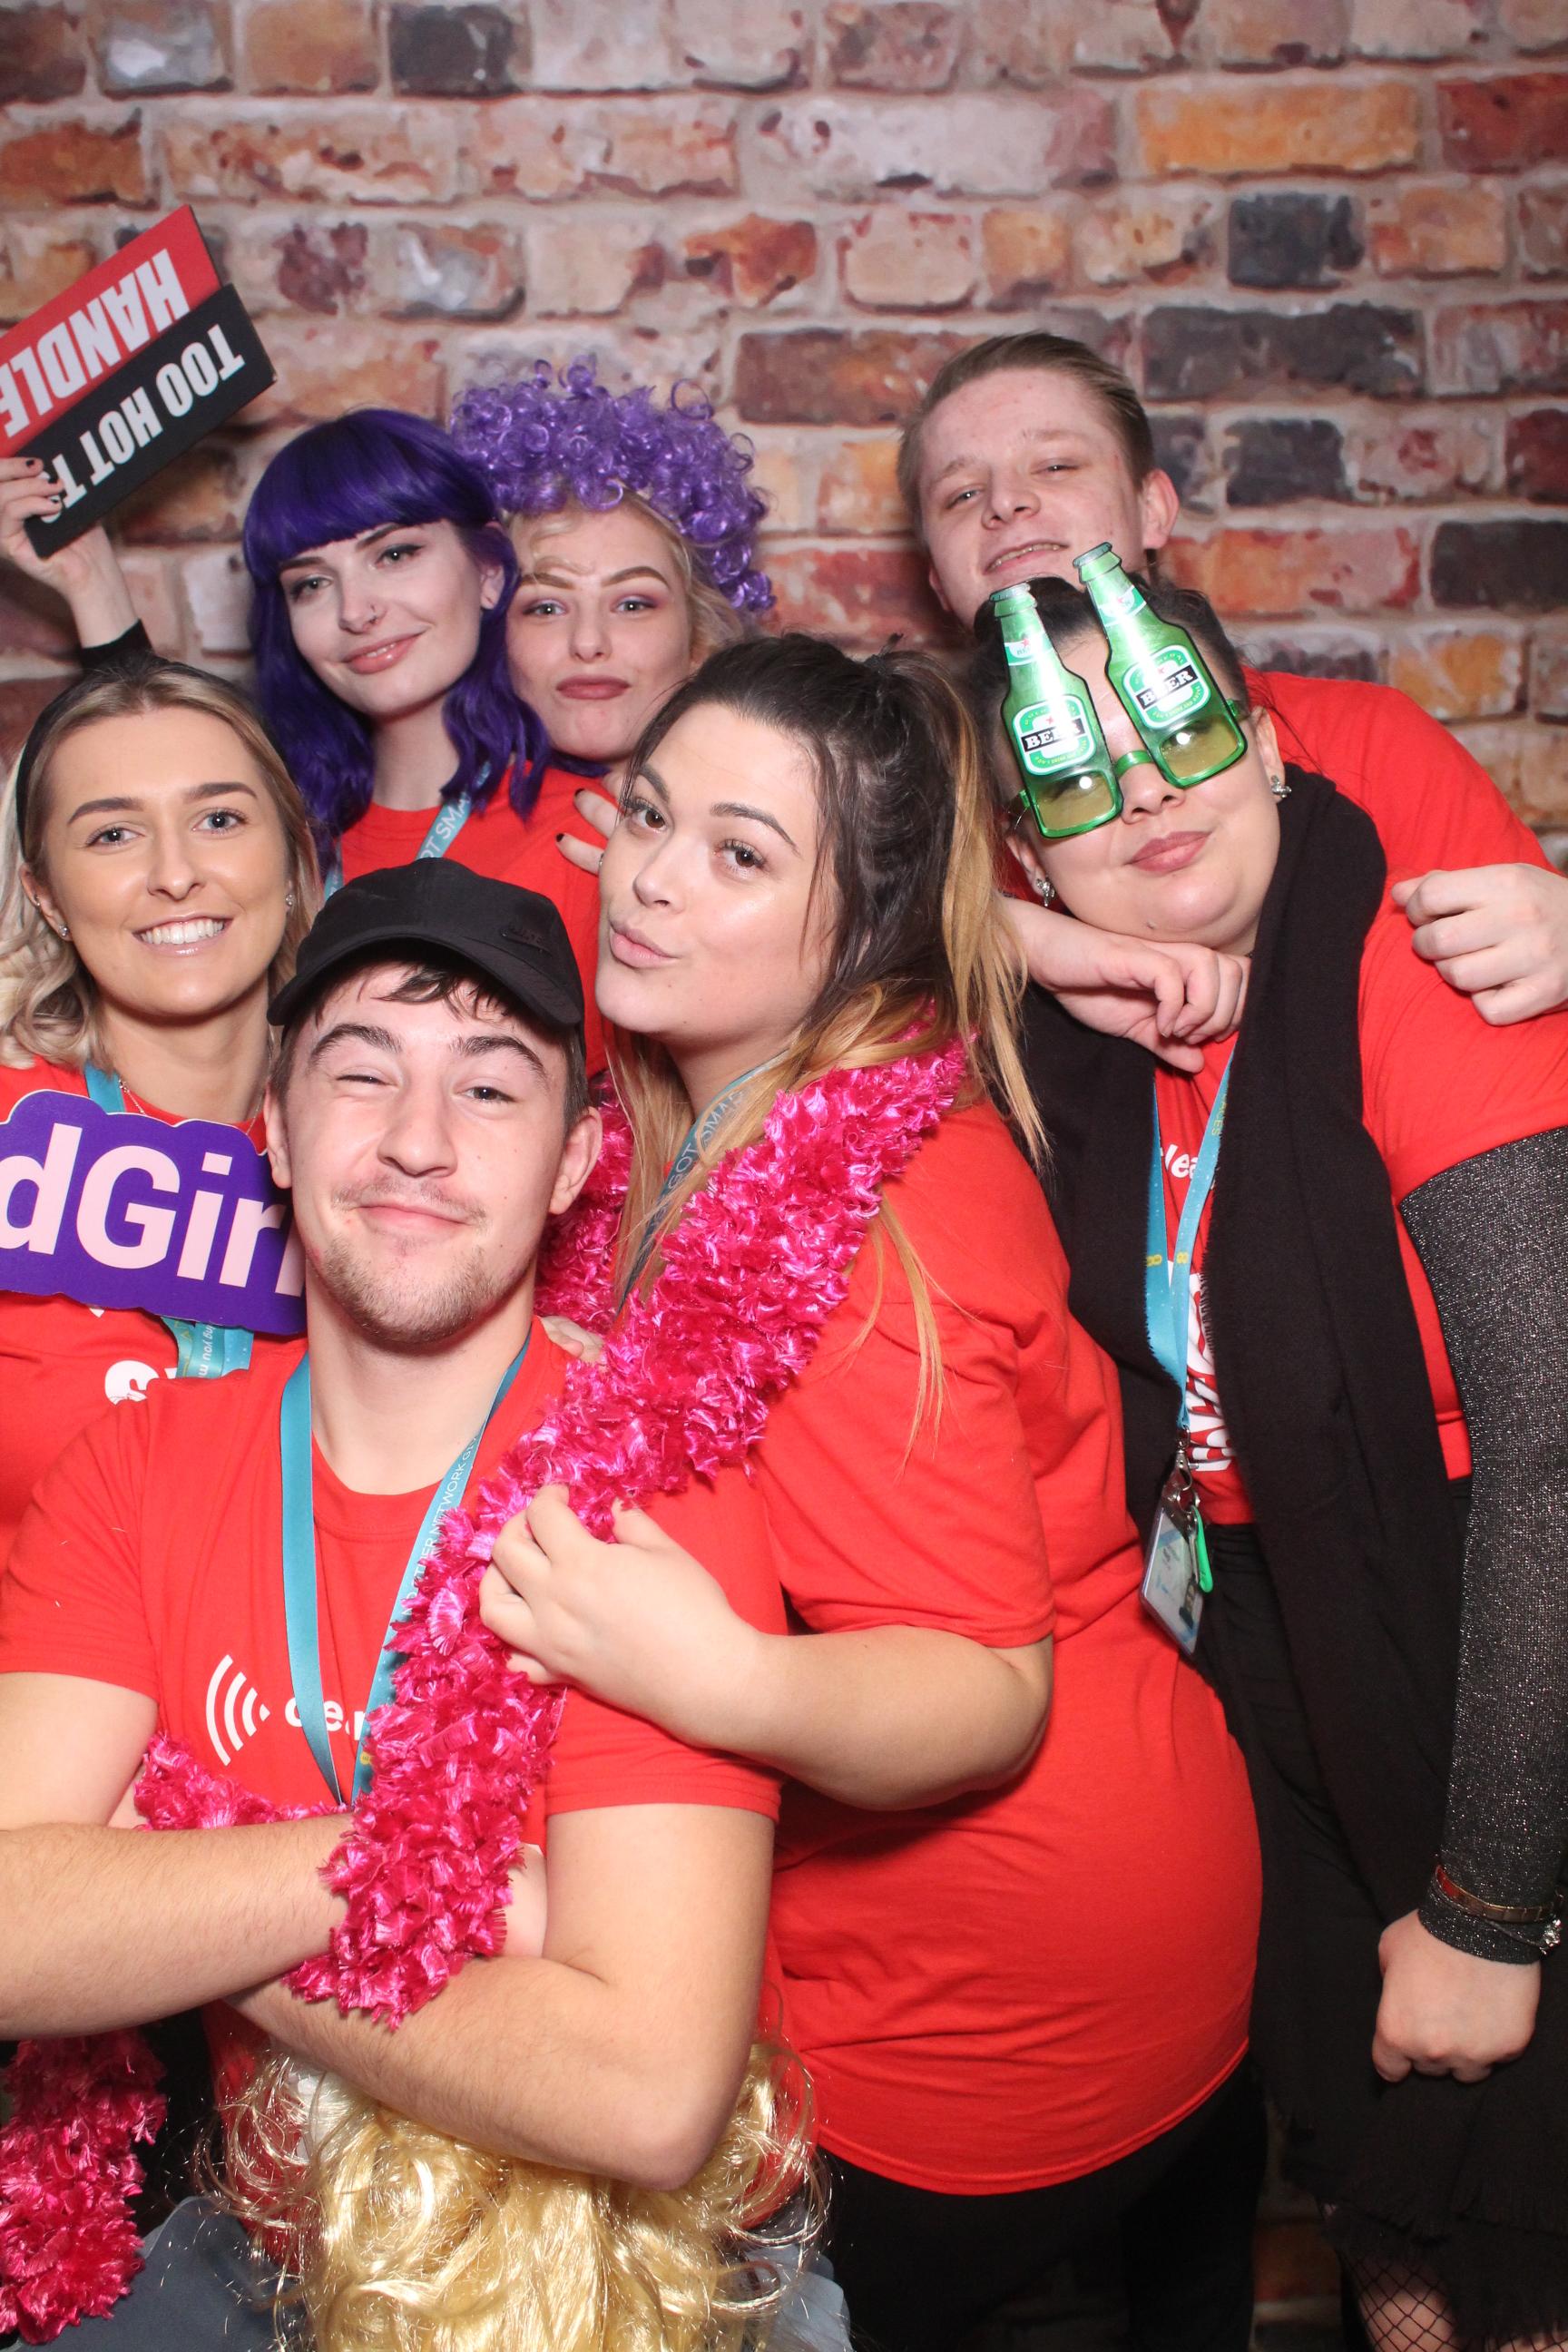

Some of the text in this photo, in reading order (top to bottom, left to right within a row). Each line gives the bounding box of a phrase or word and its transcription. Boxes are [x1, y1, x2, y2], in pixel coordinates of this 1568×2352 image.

[40, 324, 245, 524] TOO HOT T
[1141, 670, 1195, 706] BER
